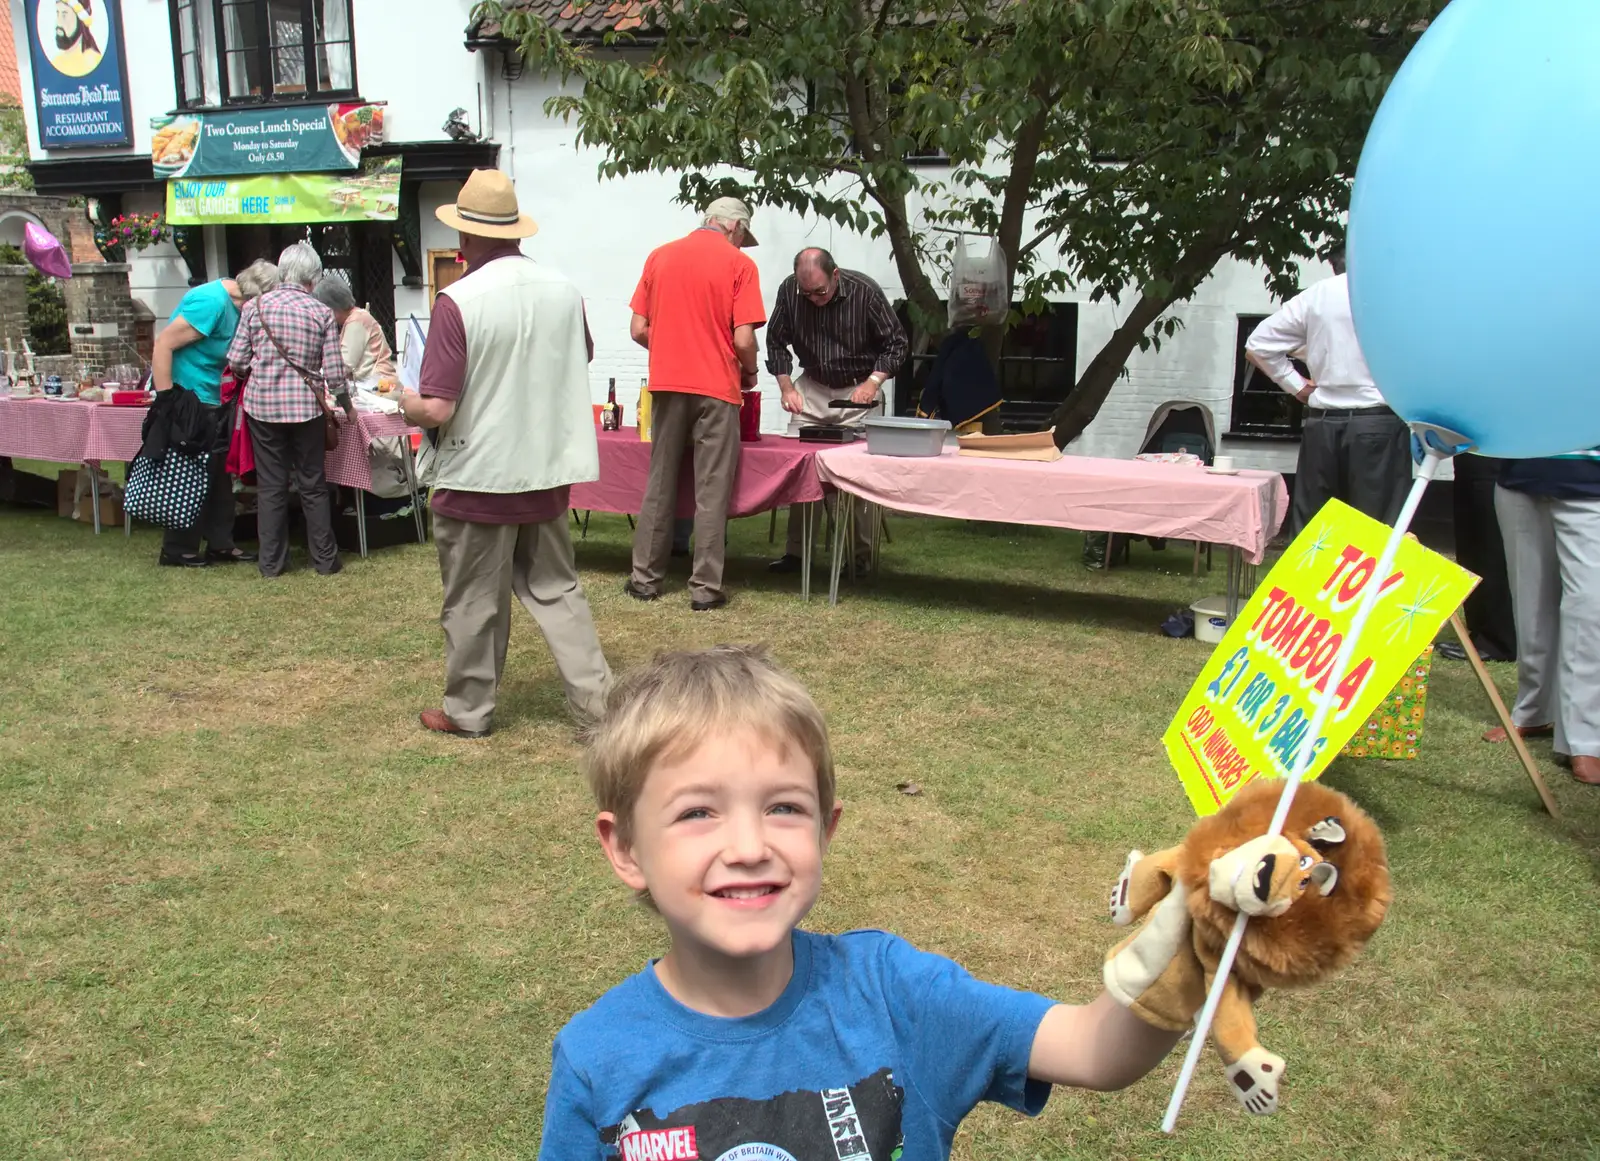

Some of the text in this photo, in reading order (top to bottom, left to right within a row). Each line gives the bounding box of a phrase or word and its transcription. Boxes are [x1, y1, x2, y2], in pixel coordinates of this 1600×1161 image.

[101, 83, 120, 104] Inn
[55, 111, 109, 124] RESTAURANT
[204, 117, 327, 137] Two Course Lunch Special
[46, 122, 122, 136] ACCOMMODATION
[233, 138, 299, 152] Monday to Saturday
[248, 152, 265, 164] Only
[173, 180, 227, 199] ENJOY OUR
[175, 198, 197, 216] BEER
[199, 197, 239, 216] GARDEN
[241, 196, 270, 214] HERE
[1207, 646, 1249, 698] £1
[1236, 671, 1276, 721] FOR
[1258, 694, 1290, 733] 3
[1187, 704, 1250, 790] ODD NUMBERS
[622, 1128, 696, 1161] MARVEL
[728, 1151, 739, 1161] OF
[740, 1146, 775, 1156] BRITAIN
